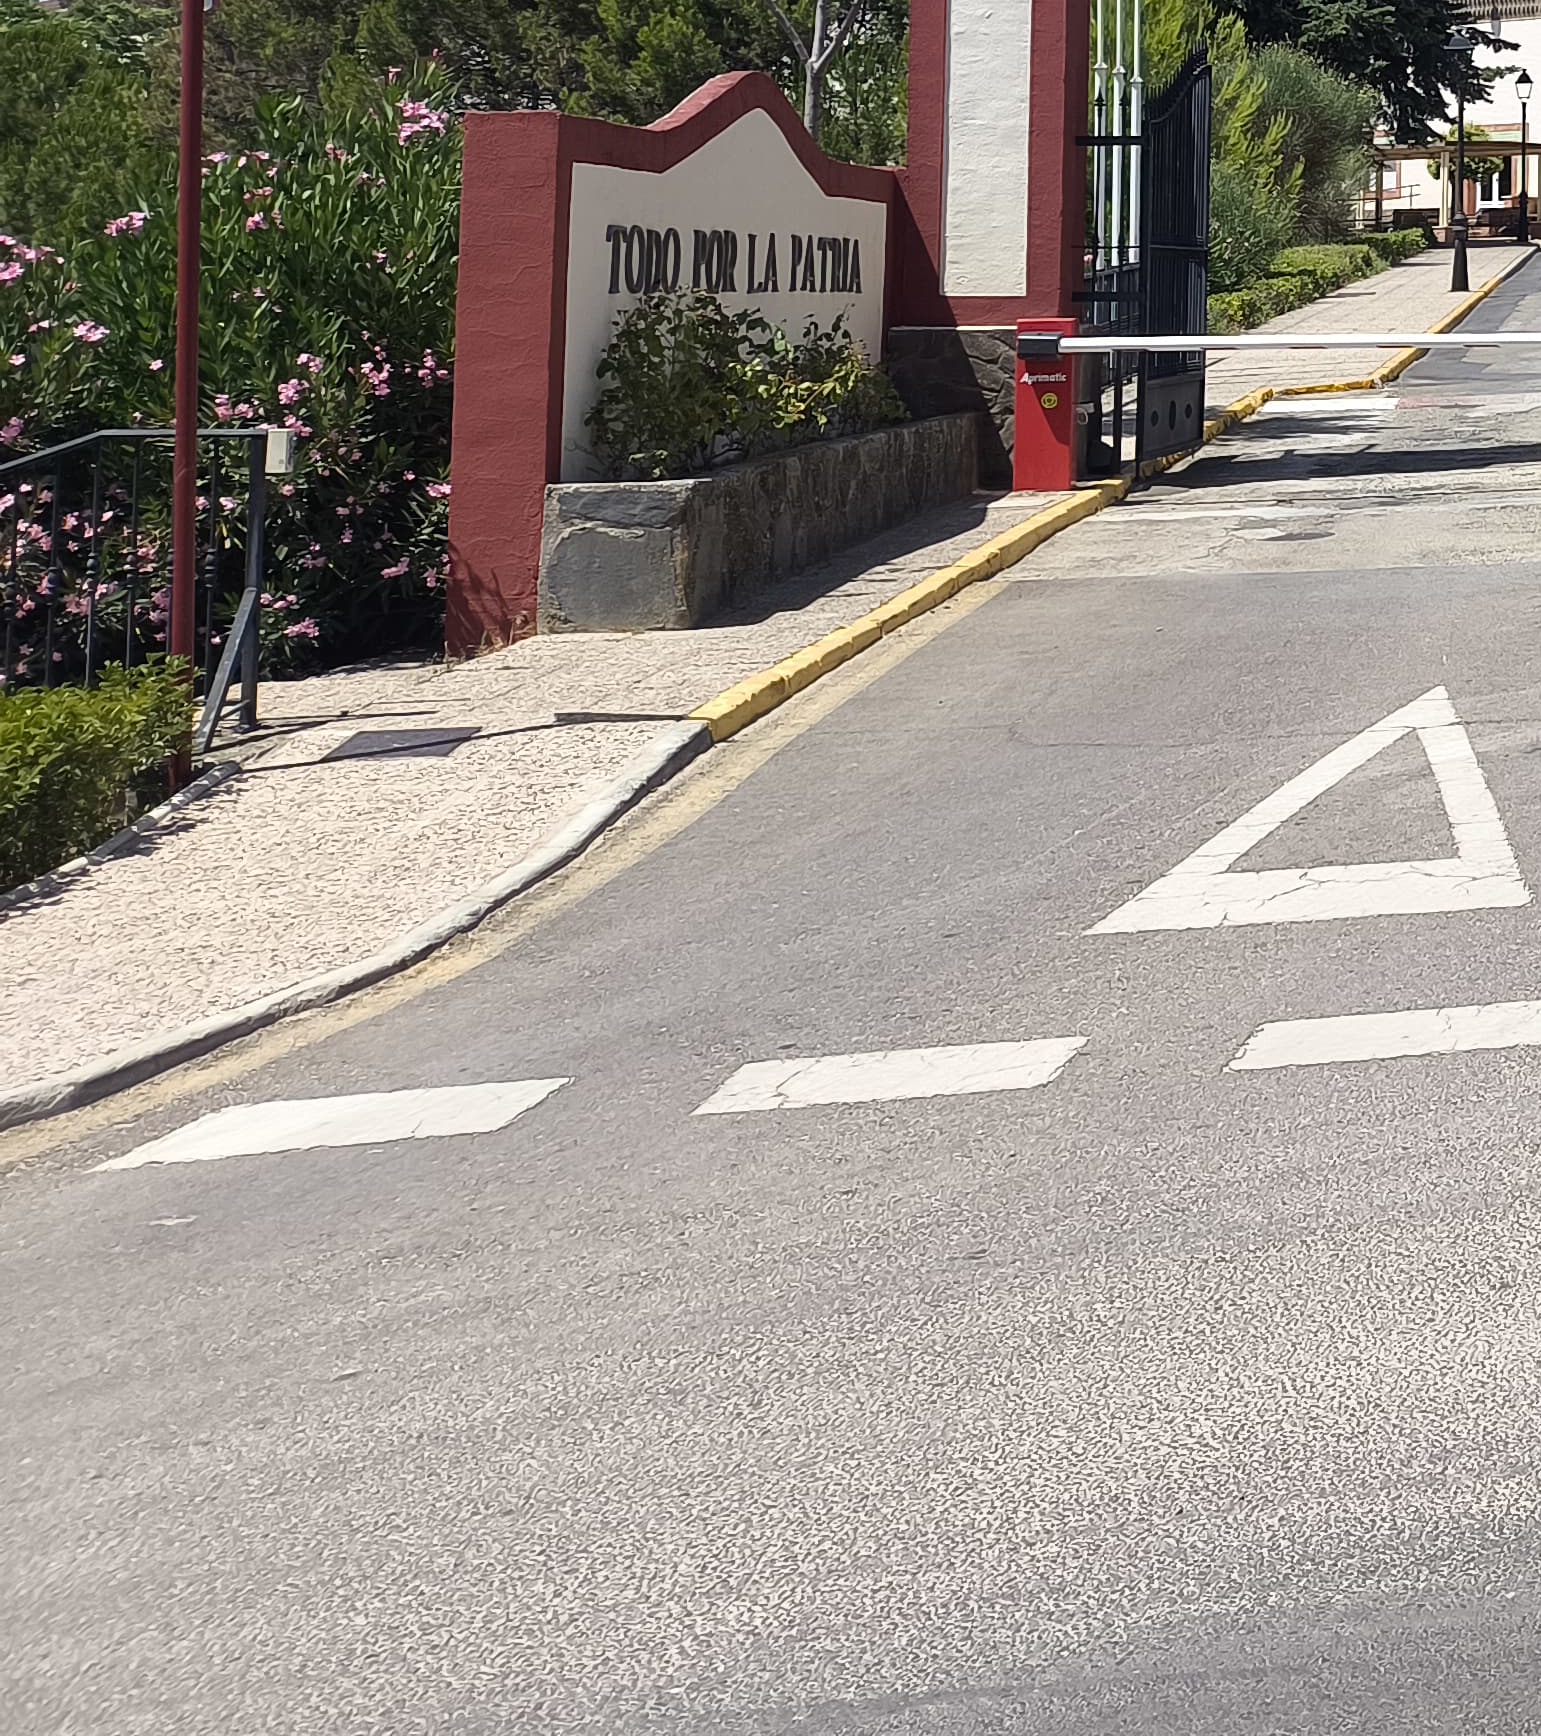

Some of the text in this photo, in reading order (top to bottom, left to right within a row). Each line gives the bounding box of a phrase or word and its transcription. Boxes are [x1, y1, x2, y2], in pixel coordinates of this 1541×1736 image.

[606, 224, 862, 294] TODO POR LA PATRIA
